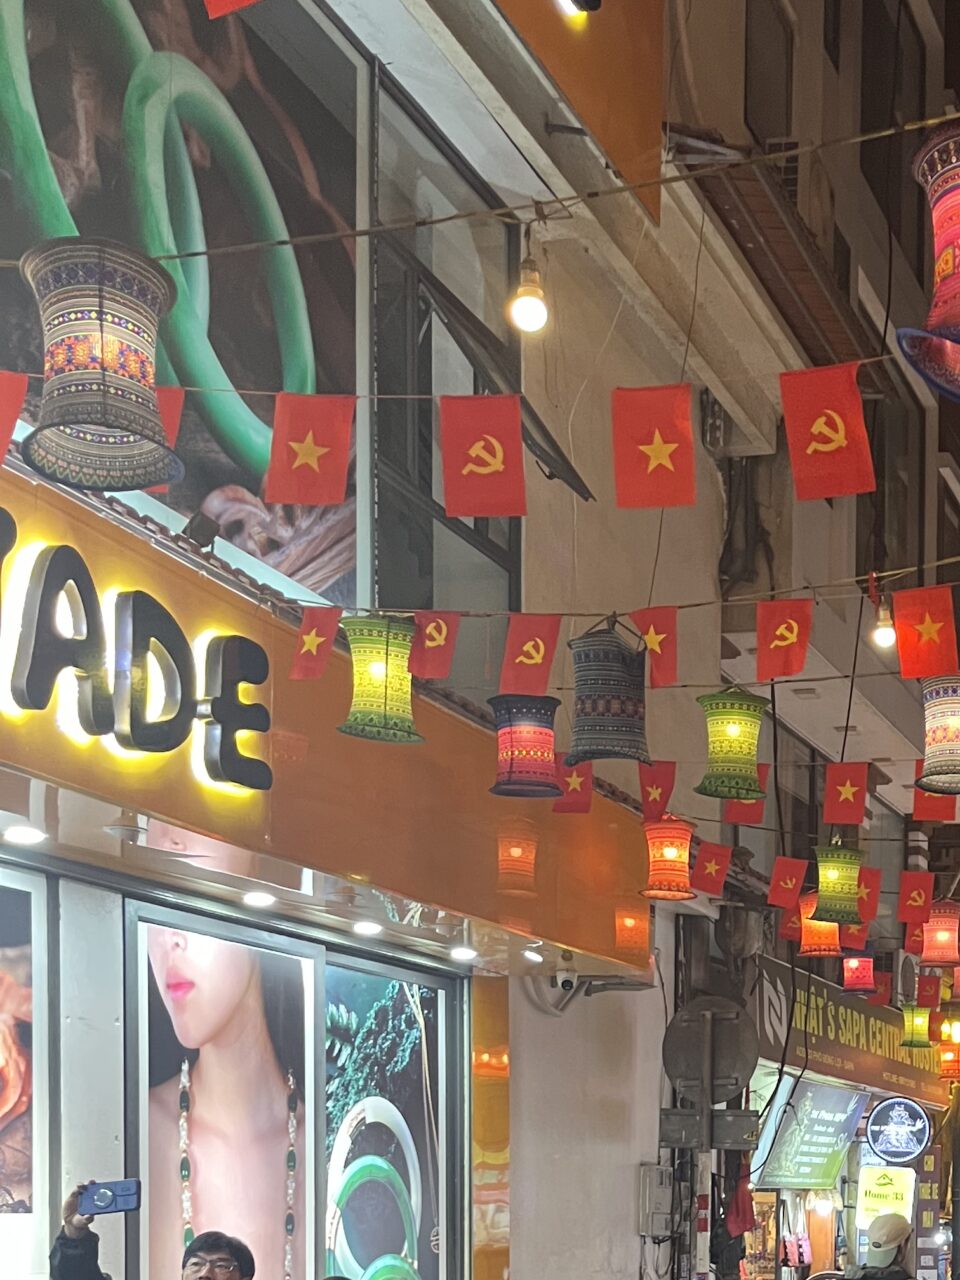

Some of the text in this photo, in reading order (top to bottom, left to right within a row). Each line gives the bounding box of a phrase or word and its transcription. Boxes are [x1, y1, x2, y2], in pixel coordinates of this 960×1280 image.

[0, 506, 274, 791] ADE
[838, 1005, 867, 1051] SAPA
[864, 1189, 890, 1199] Home
